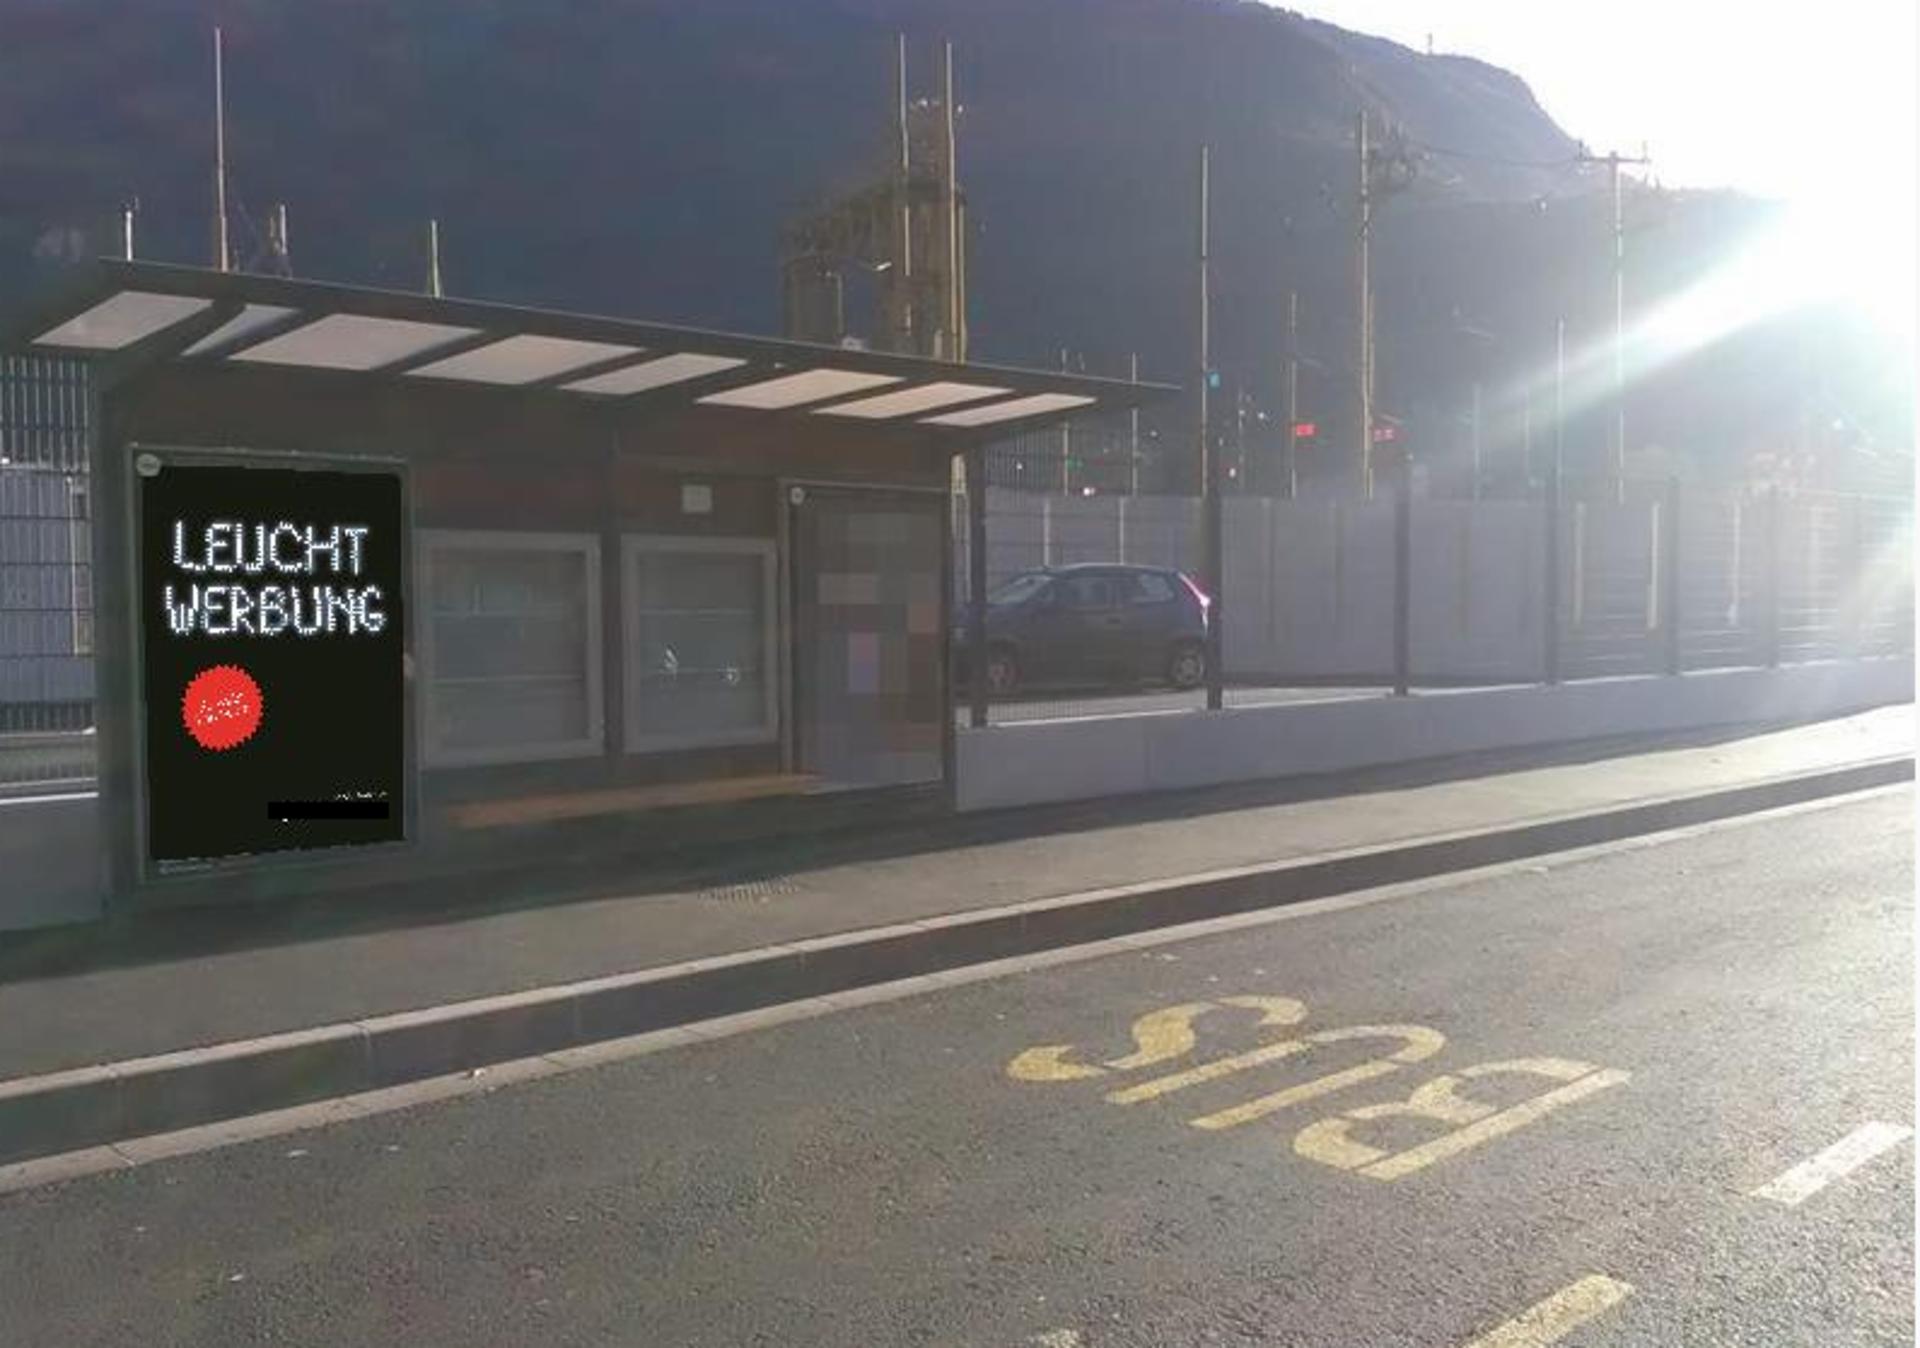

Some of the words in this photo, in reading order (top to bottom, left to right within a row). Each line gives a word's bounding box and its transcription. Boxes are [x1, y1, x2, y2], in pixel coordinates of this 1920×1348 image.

[174, 521, 368, 574] LEUCHT
[165, 585, 387, 635] WERBUNG
[1007, 995, 1632, 1181] BUS
